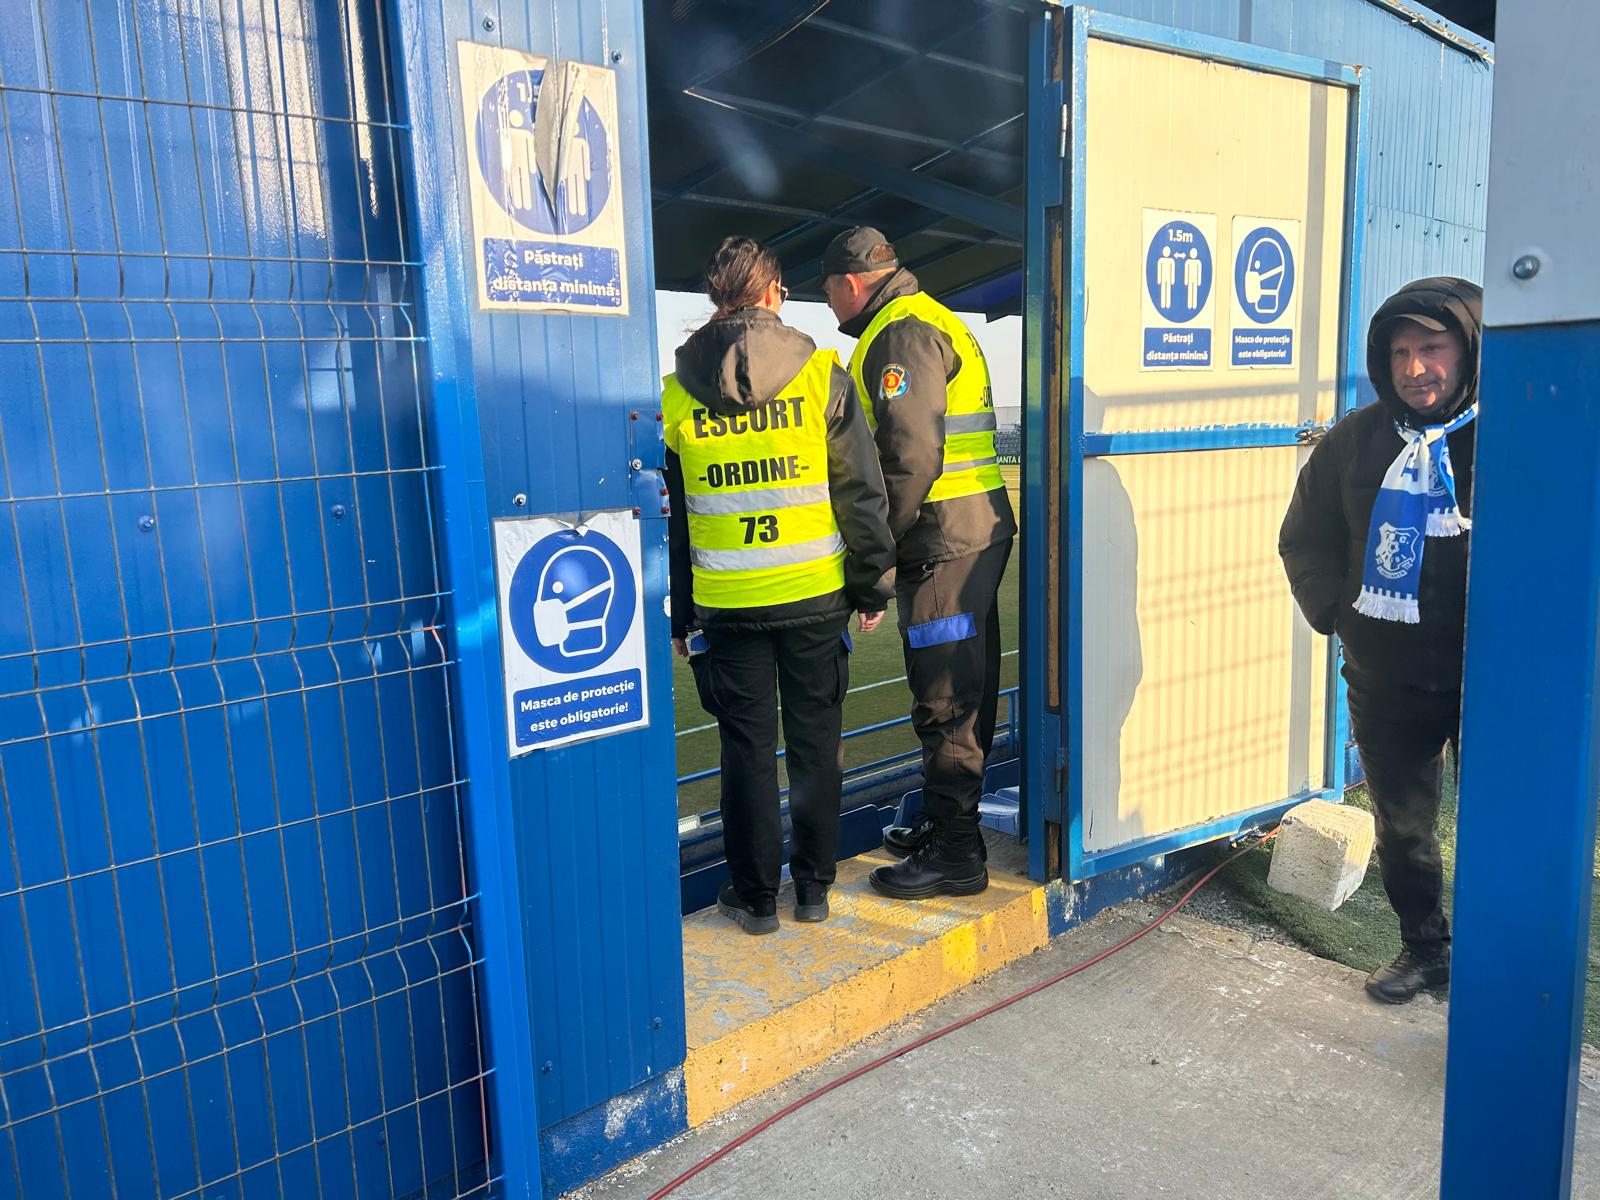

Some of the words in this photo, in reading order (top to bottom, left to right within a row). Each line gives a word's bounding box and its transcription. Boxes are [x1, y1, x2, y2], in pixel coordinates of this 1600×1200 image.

[1168, 229, 1193, 243] 1.5m
[1235, 335, 1254, 343] Masca
[1254, 335, 1263, 343] de
[1238, 350, 1251, 358] este
[692, 396, 804, 439] ESCORT
[698, 455, 809, 488] -ORDINE-
[739, 515, 779, 544] 73
[520, 696, 561, 712] Masca
[563, 691, 579, 703] de
[581, 680, 635, 701] protecție
[530, 718, 558, 732] este
[560, 702, 629, 725] obligatorie!
